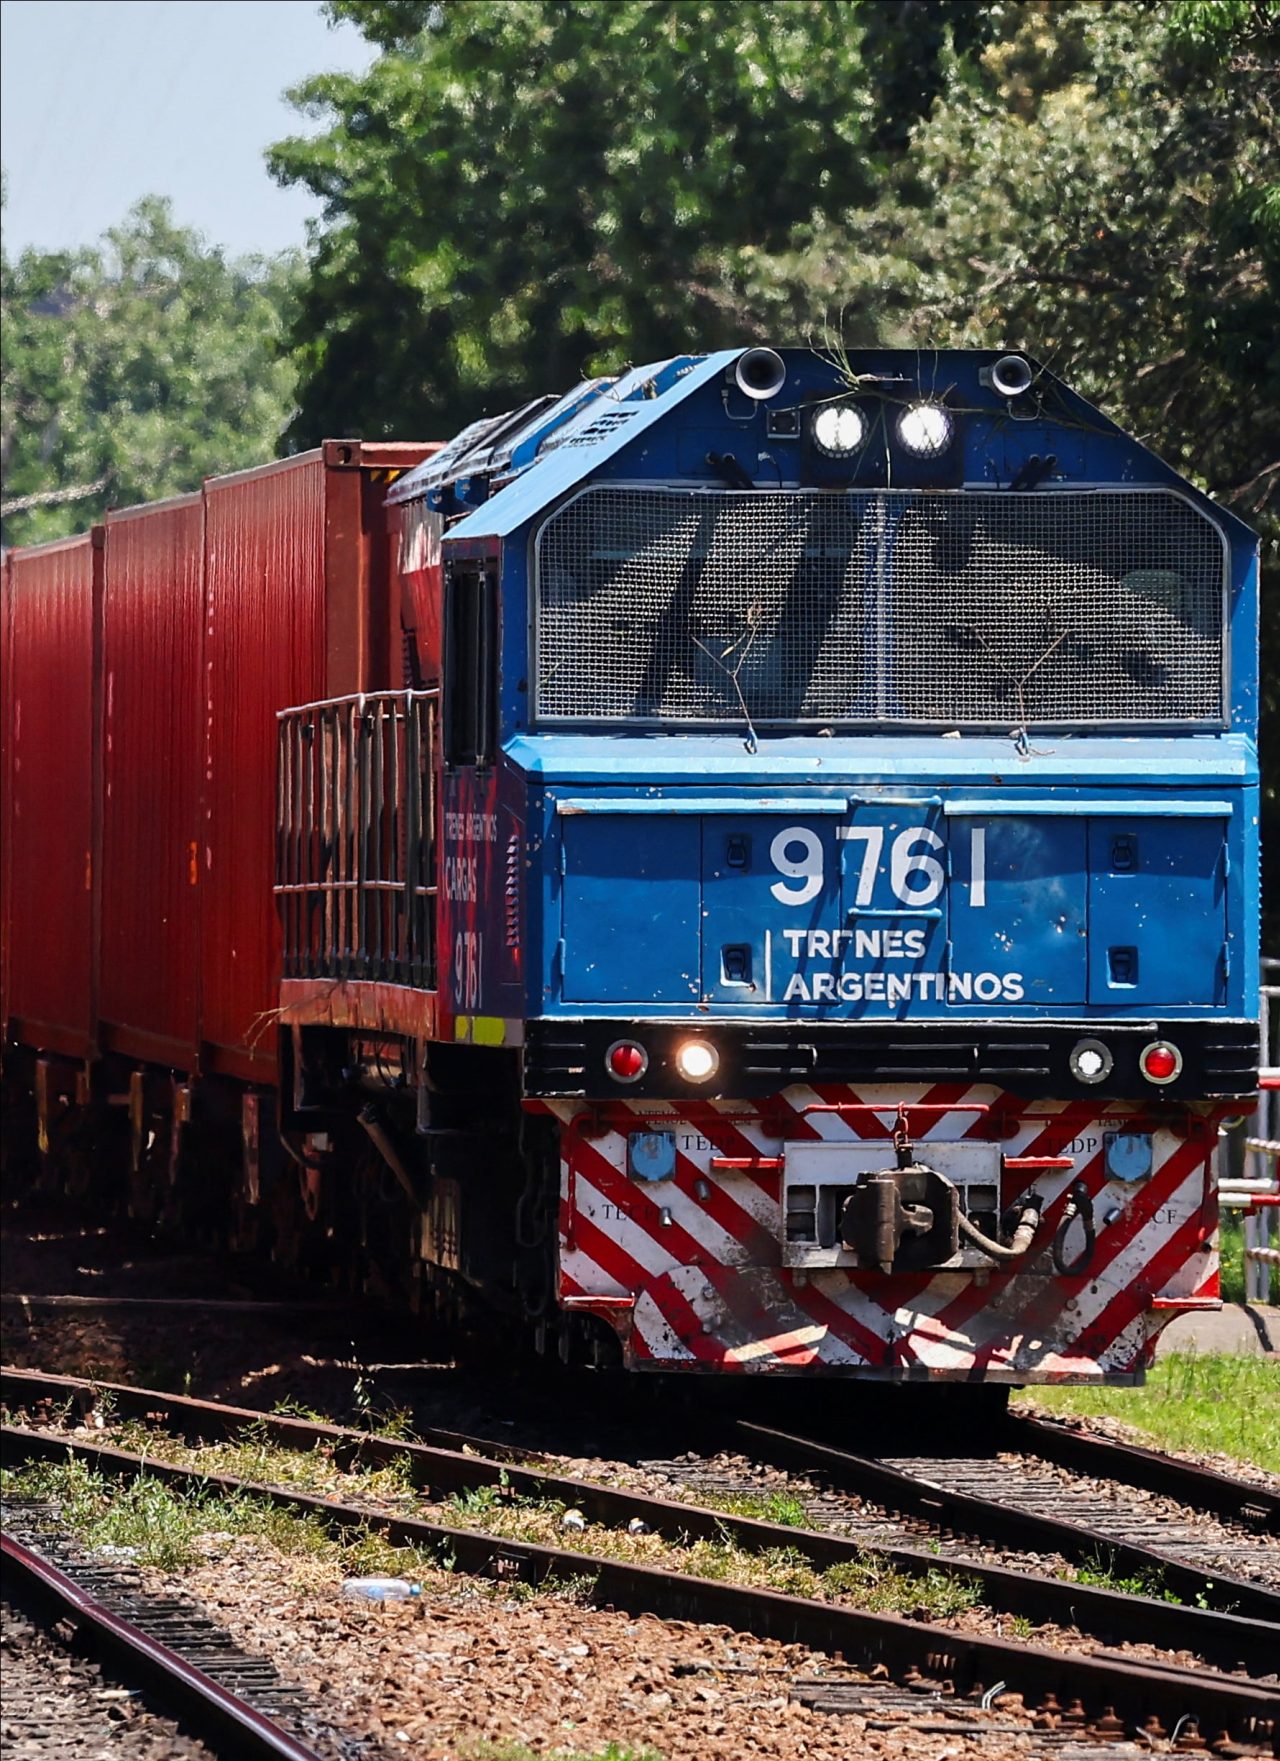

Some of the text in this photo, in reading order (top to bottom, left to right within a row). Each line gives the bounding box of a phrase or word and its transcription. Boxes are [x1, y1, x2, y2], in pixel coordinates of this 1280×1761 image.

[445, 856, 477, 903] CARGAS
[769, 826, 985, 907] 9761
[455, 931, 483, 1009] 9761
[783, 972, 1025, 1001] ARGENTINOS
